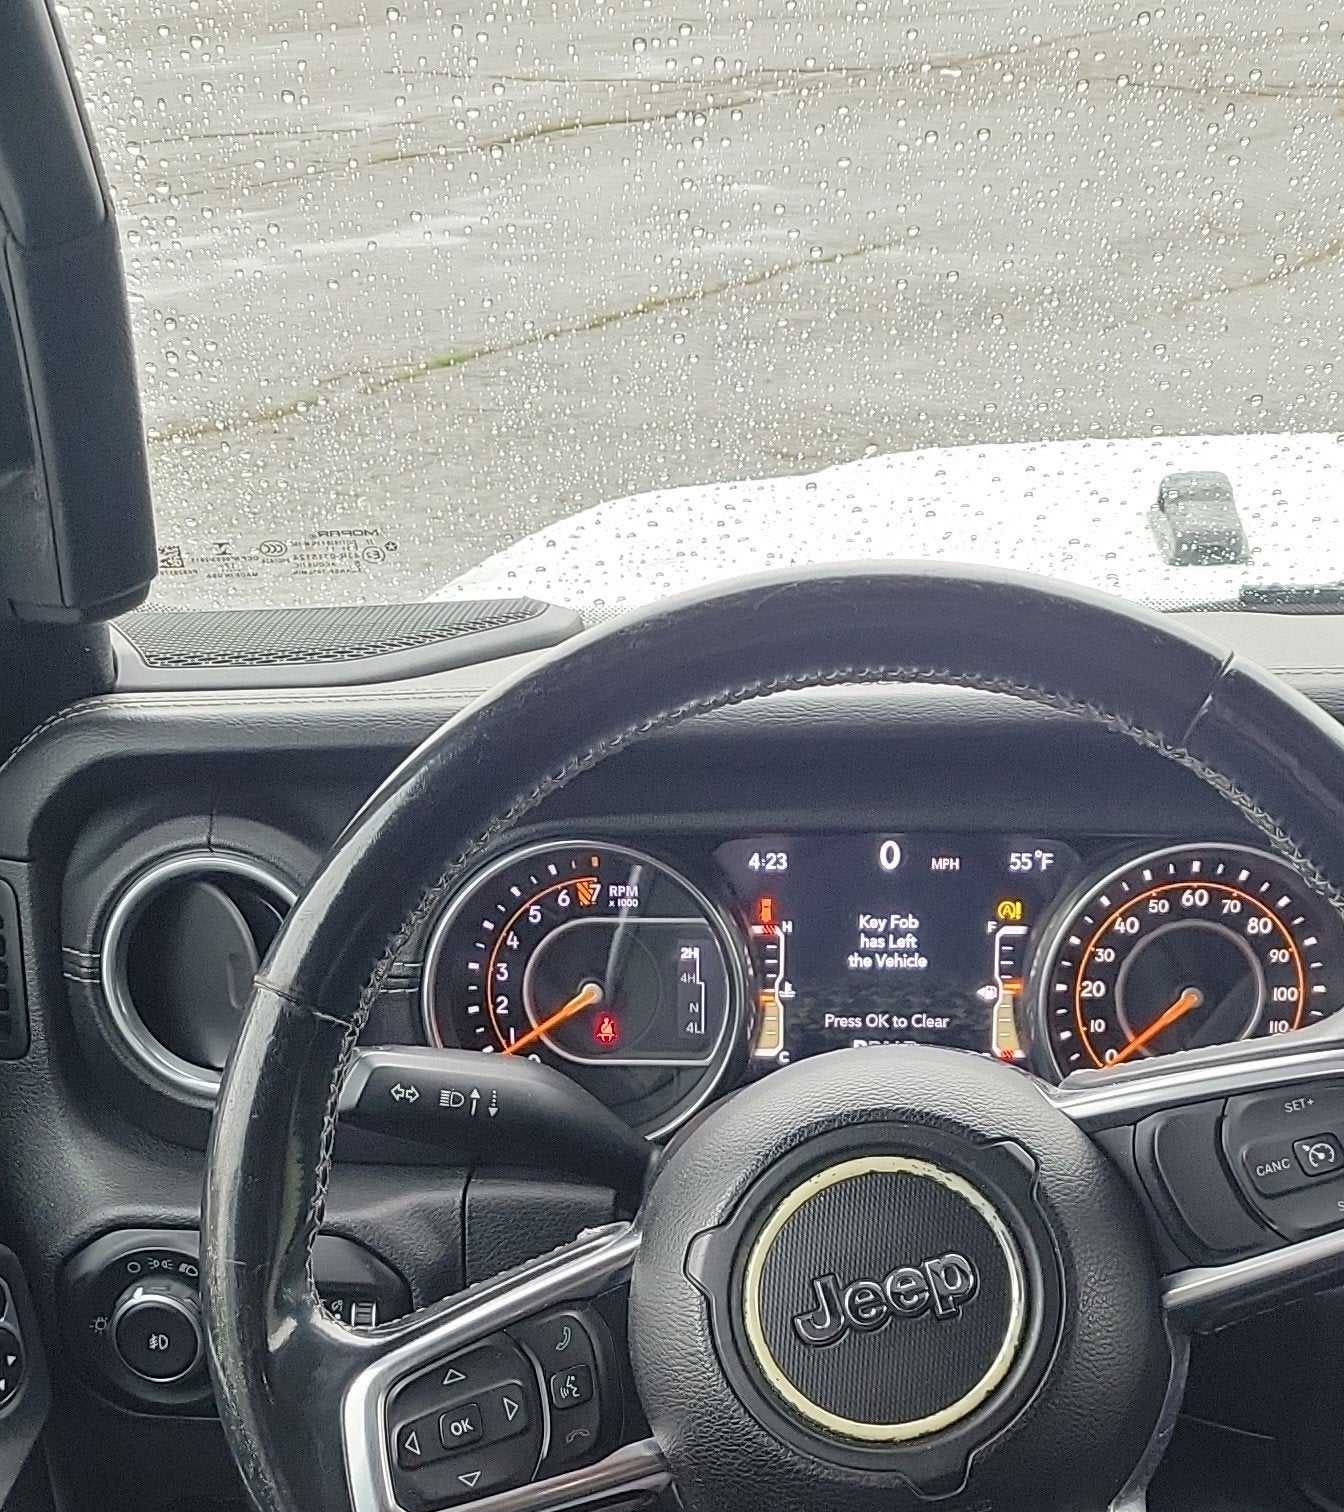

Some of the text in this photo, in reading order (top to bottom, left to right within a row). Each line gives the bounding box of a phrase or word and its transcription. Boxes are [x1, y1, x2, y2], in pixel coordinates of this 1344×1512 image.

[748, 852, 788, 871] 4:23
[879, 840, 960, 871] 0 MPH
[558, 889, 571, 907] 6
[590, 884, 602, 902] 7
[609, 885, 639, 897] RPM
[1182, 889, 1209, 906] 60
[617, 898, 639, 908] 1000
[1148, 900, 1170, 913] 50
[1222, 900, 1242, 913] 70
[528, 905, 541, 923] 5
[782, 921, 793, 933] H
[859, 914, 920, 932] Key Fob
[987, 921, 997, 933] F
[1114, 916, 1140, 934] 40
[1247, 917, 1273, 934] 80
[506, 931, 520, 949] 4
[860, 933, 918, 949] has Left
[848, 953, 928, 969] the Vehicle
[1094, 949, 1116, 963] 30
[1269, 949, 1290, 963] 90
[496, 963, 509, 981] 3
[680, 972, 697, 983] 4H
[1081, 981, 1106, 998] 20
[1273, 987, 1298, 1001] 100
[496, 996, 509, 1014] 2
[689, 1003, 699, 1013] N
[824, 1013, 950, 1029] Press OK to Clear
[1090, 1019, 1105, 1033] 10
[1269, 1021, 1290, 1034] 110
[509, 1027, 515, 1045] 1
[779, 1051, 790, 1063] C
[1105, 1049, 1118, 1064] 0
[1256, 1158, 1291, 1177] CANC
[793, 1250, 978, 1345] Jeep
[450, 1417, 474, 1436] OK
